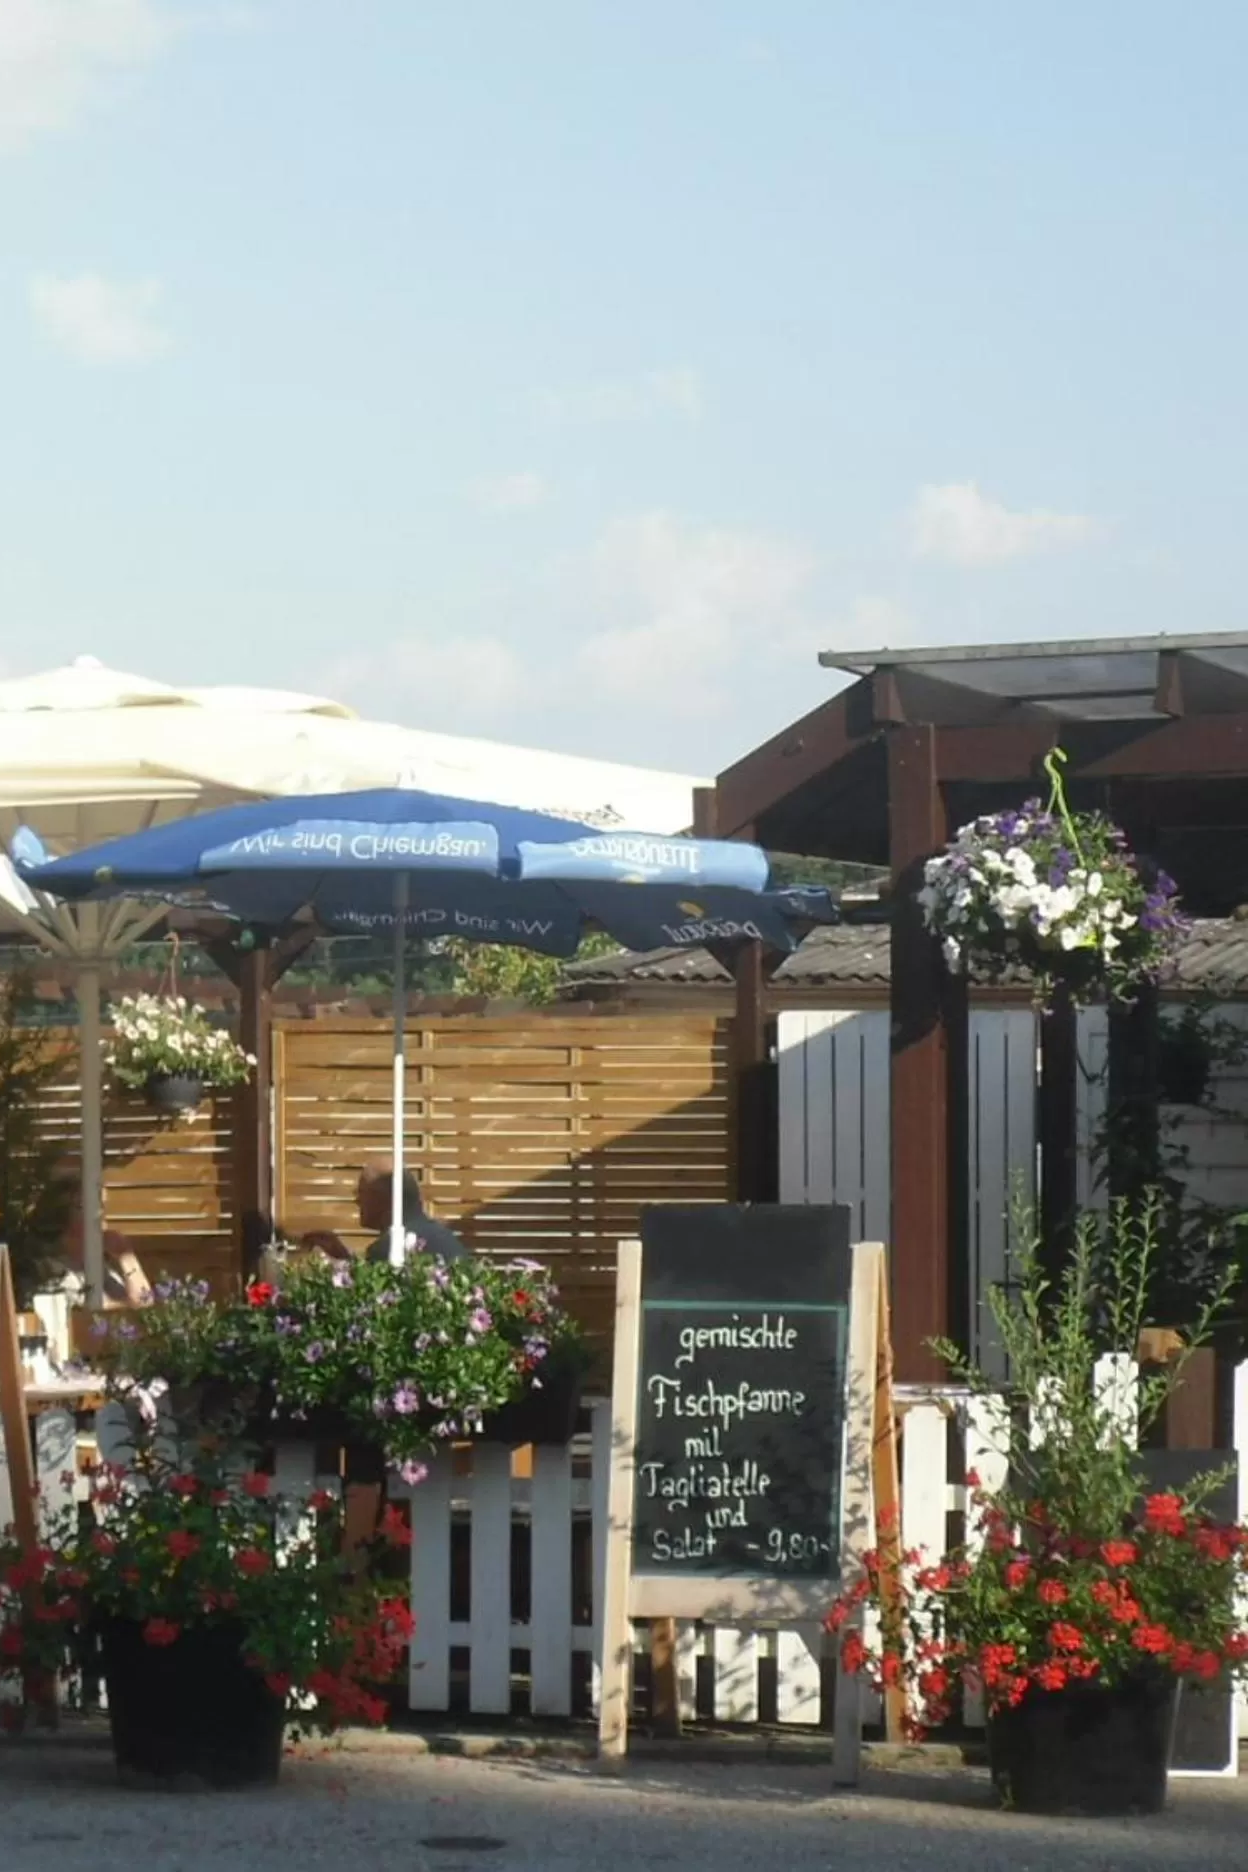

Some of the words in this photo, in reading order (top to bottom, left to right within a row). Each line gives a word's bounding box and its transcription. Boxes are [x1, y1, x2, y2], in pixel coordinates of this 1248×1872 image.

[675, 1313, 798, 1368] gemischte
[647, 1374, 806, 1431] Fischpfanne
[684, 1427, 723, 1458] mit
[639, 1460, 771, 1511] Tagliatelle
[705, 1500, 748, 1528] und
[652, 1526, 716, 1561] Salat
